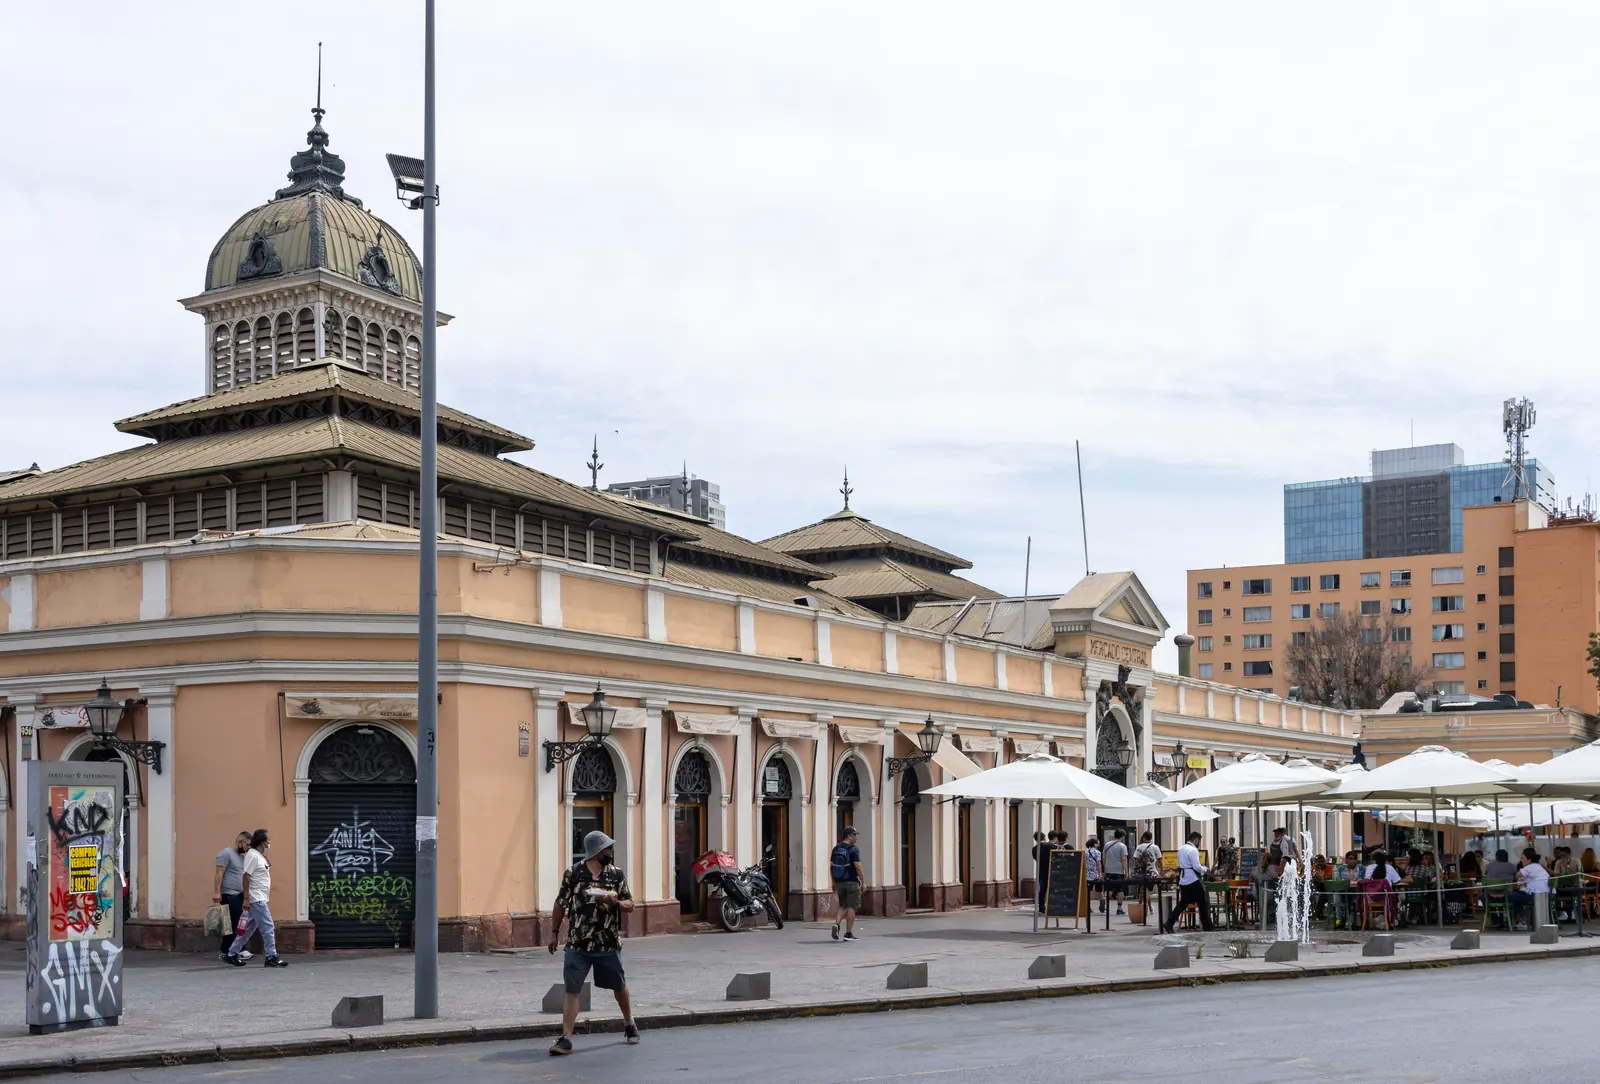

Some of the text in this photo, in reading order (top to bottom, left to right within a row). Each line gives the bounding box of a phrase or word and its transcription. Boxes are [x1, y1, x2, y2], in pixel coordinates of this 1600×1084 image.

[1090, 639, 1148, 667] MERCADO CENTRAL
[21, 727, 33, 737] 956
[70, 846, 97, 858] COMPRO
[70, 857, 97, 869] VEHICULOS
